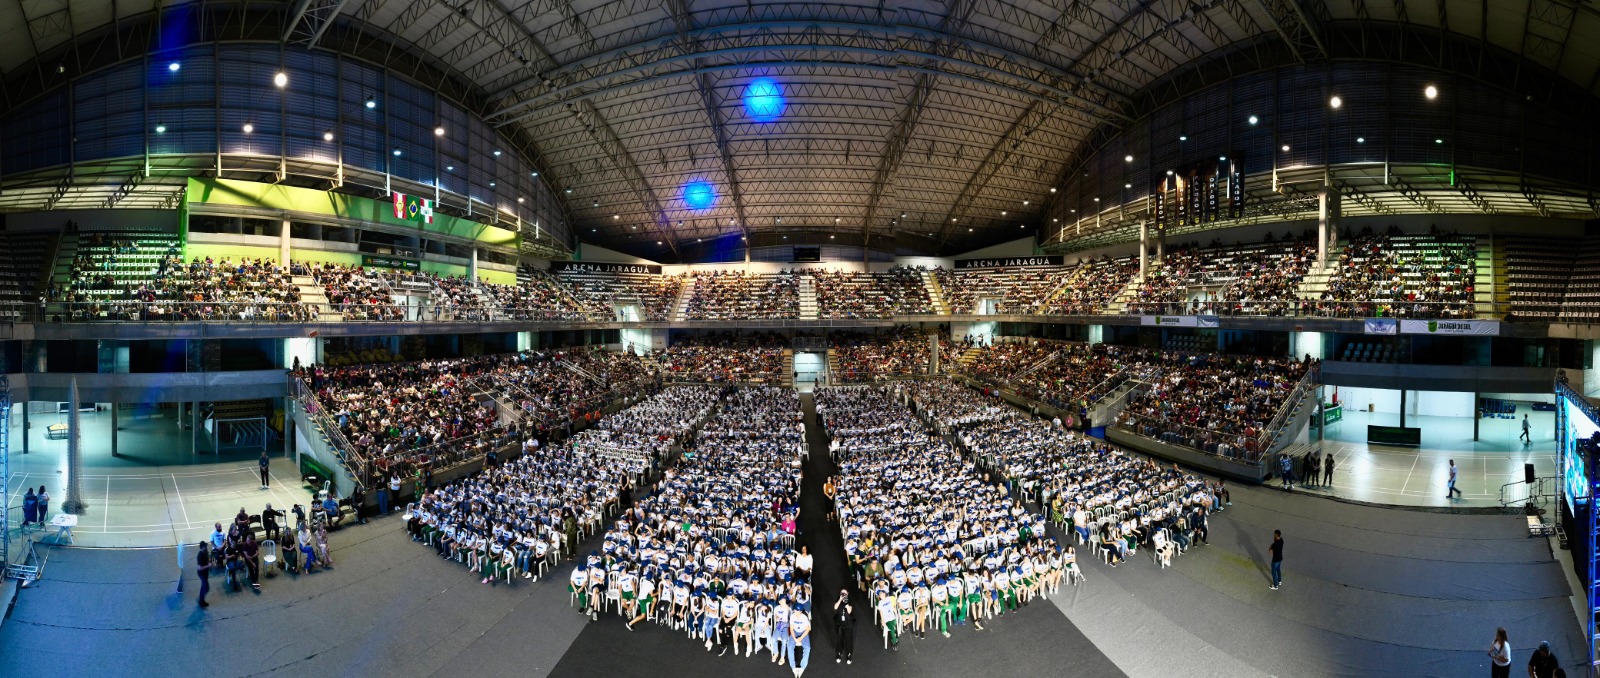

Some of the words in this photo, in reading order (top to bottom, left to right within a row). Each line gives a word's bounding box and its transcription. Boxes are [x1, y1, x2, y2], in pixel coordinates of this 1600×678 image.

[966, 260, 1000, 268] ARENA
[1004, 257, 1050, 266] JARAGUÁ
[564, 264, 602, 272] ARENA
[606, 265, 650, 274] JARAGUÁ
